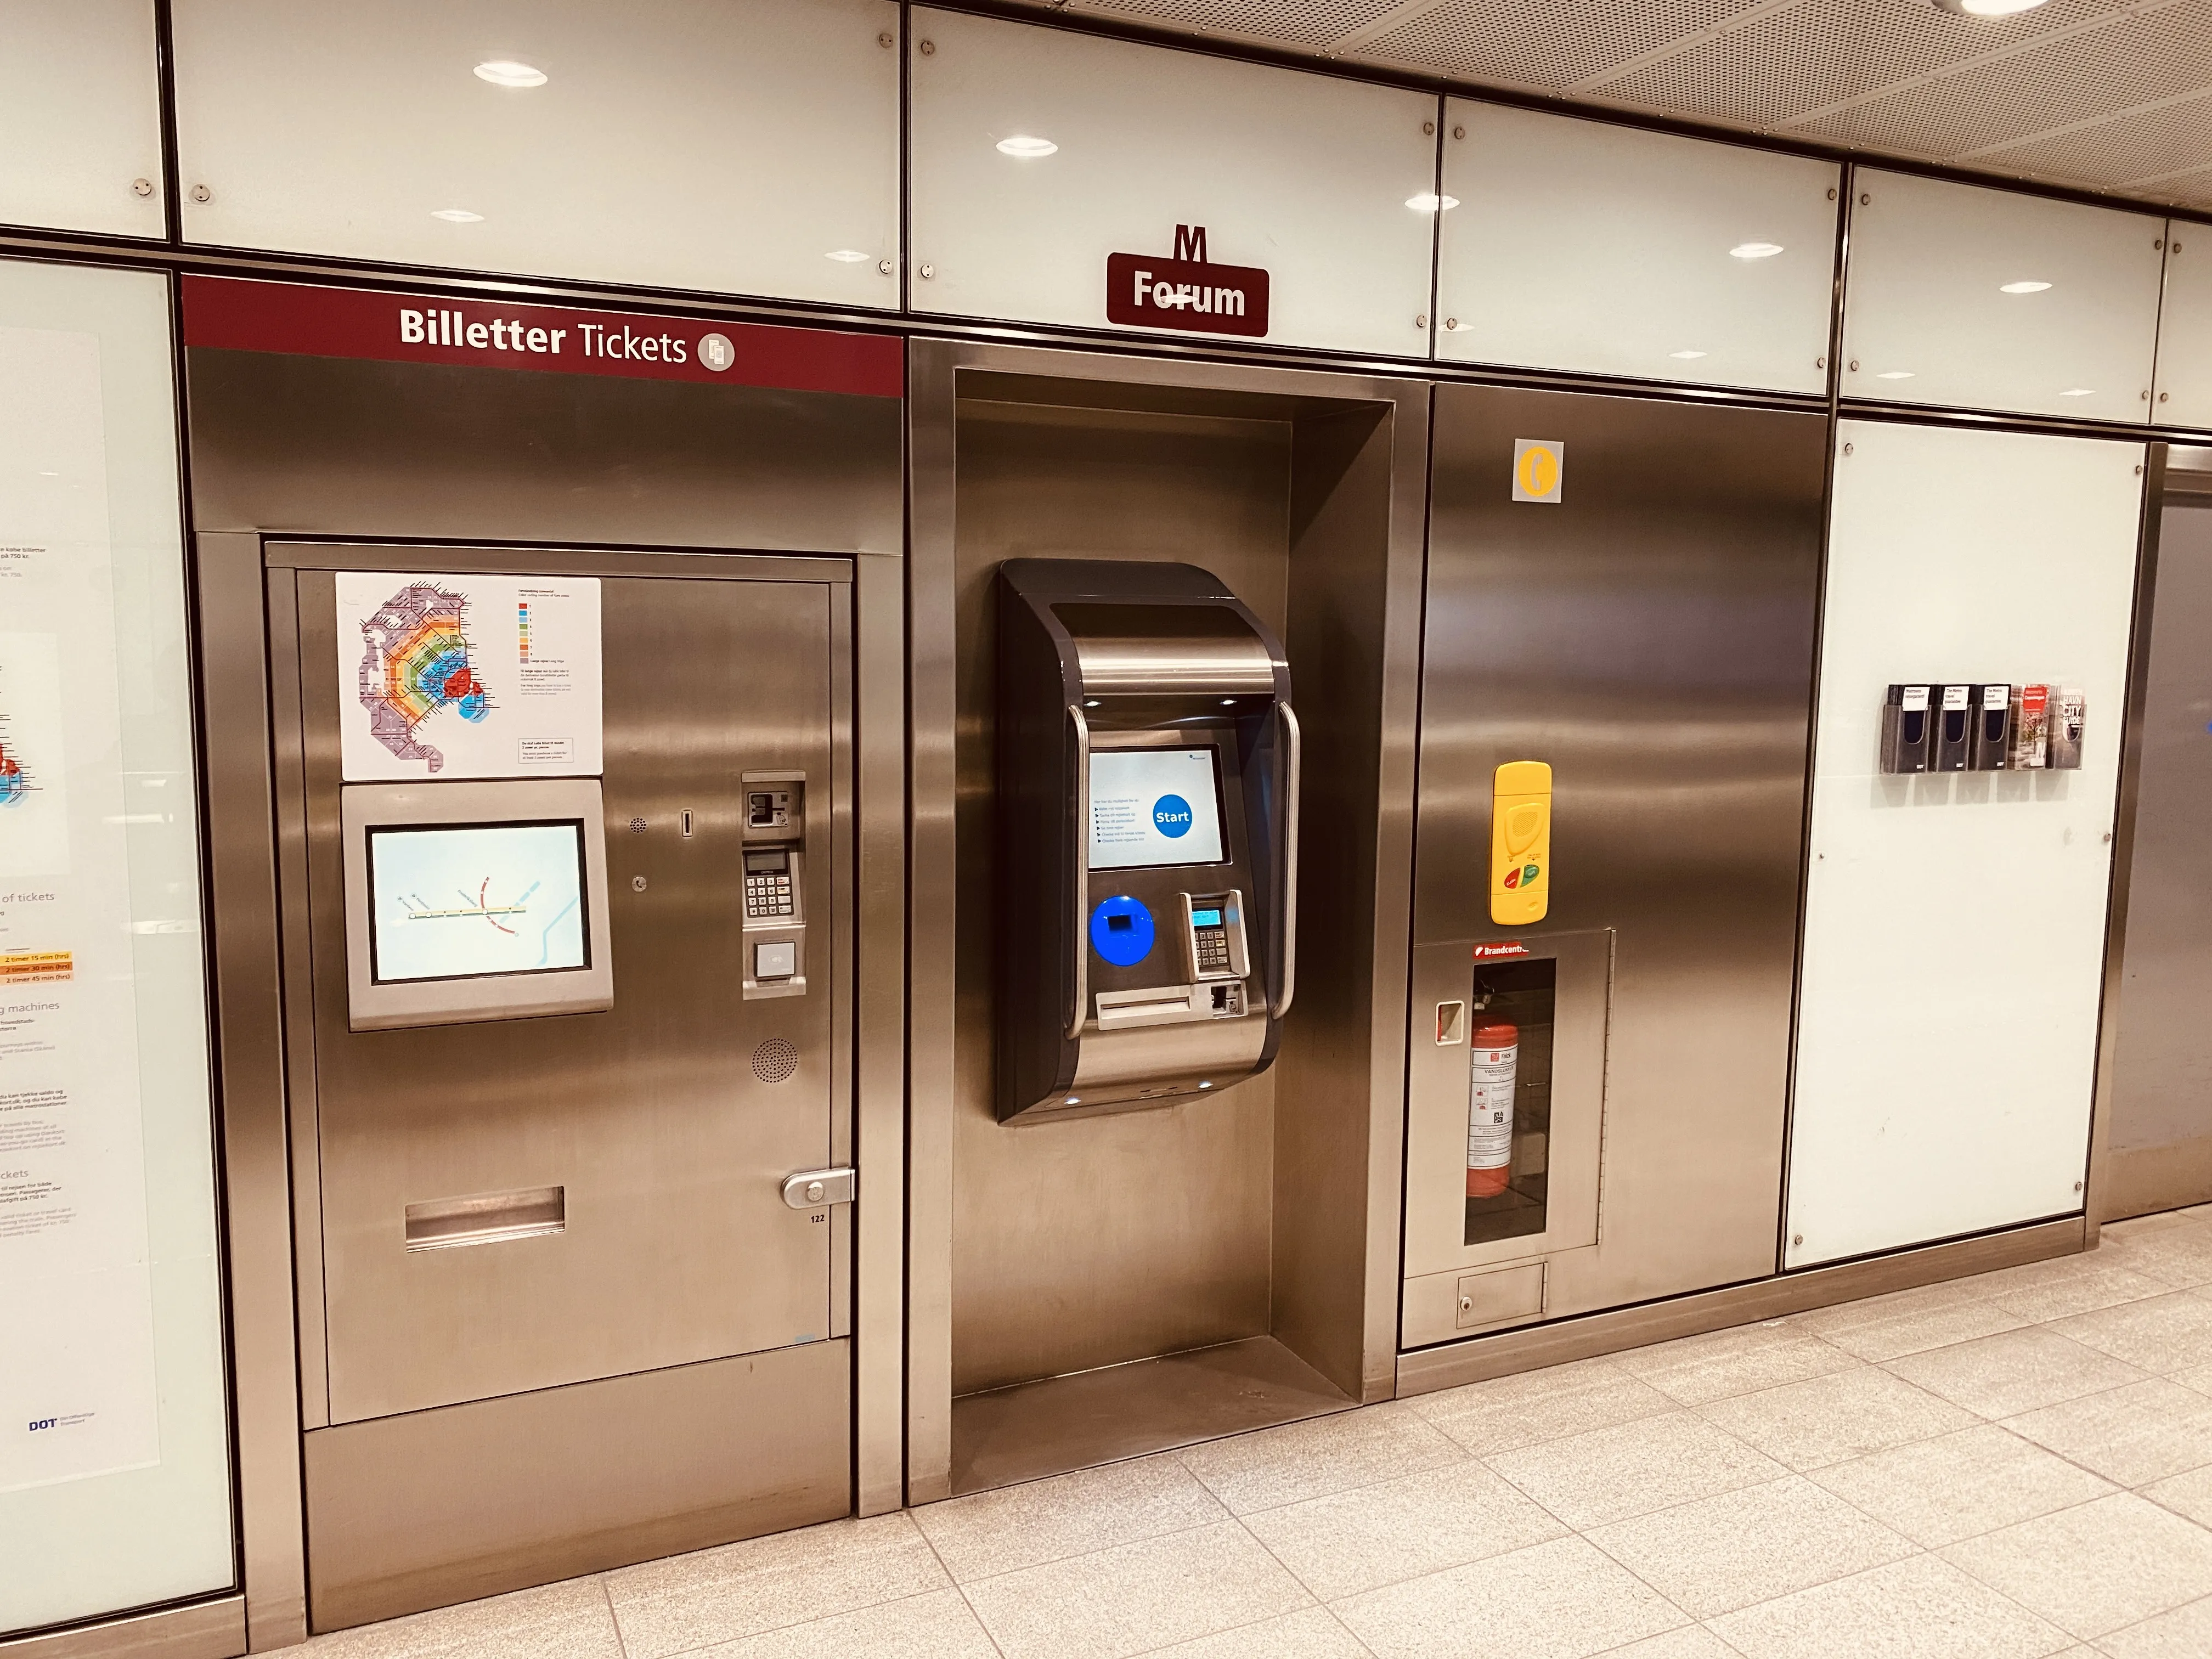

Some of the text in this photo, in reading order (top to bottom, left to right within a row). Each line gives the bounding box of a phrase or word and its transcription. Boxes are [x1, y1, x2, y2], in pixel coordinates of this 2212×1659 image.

[1173, 224, 1207, 262] M
[1134, 270, 1245, 316] Forum
[399, 309, 687, 364] Billetter Tickets
[2063, 696, 2081, 704] HAVN
[2063, 706, 2081, 716] CITY
[1156, 811, 1189, 823] Start
[2, 893, 54, 903] of tickets
[8, 1002, 59, 1013] machines
[811, 1214, 825, 1223] 122
[29, 1419, 57, 1431] DOT
